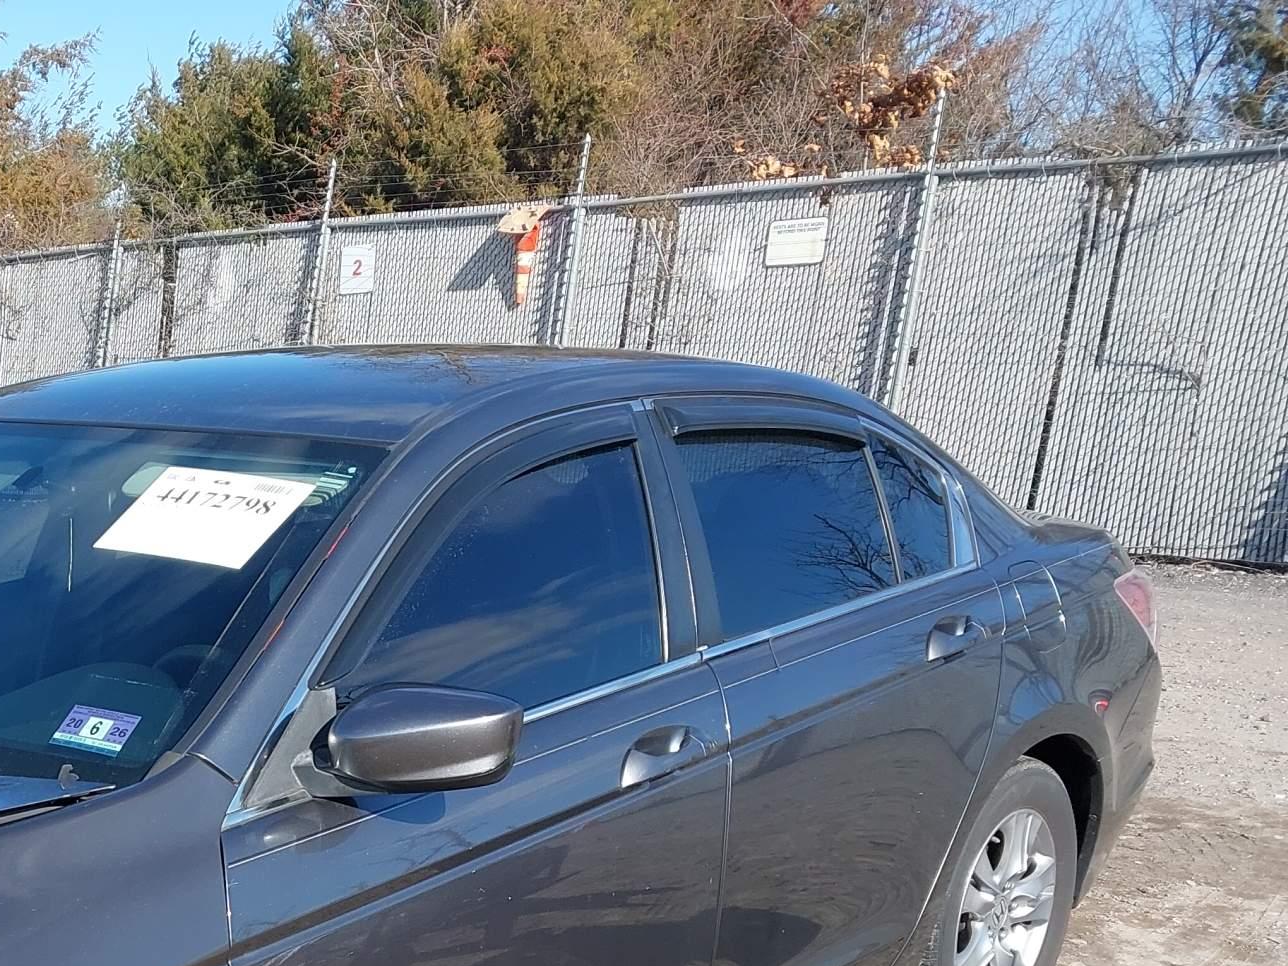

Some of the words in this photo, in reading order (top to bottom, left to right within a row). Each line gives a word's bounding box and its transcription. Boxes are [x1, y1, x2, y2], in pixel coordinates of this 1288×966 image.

[352, 259, 363, 276] 2
[156, 488, 277, 515] 44172798
[66, 718, 83, 729] 20
[90, 721, 103, 735] 6
[109, 727, 128, 738] 26
